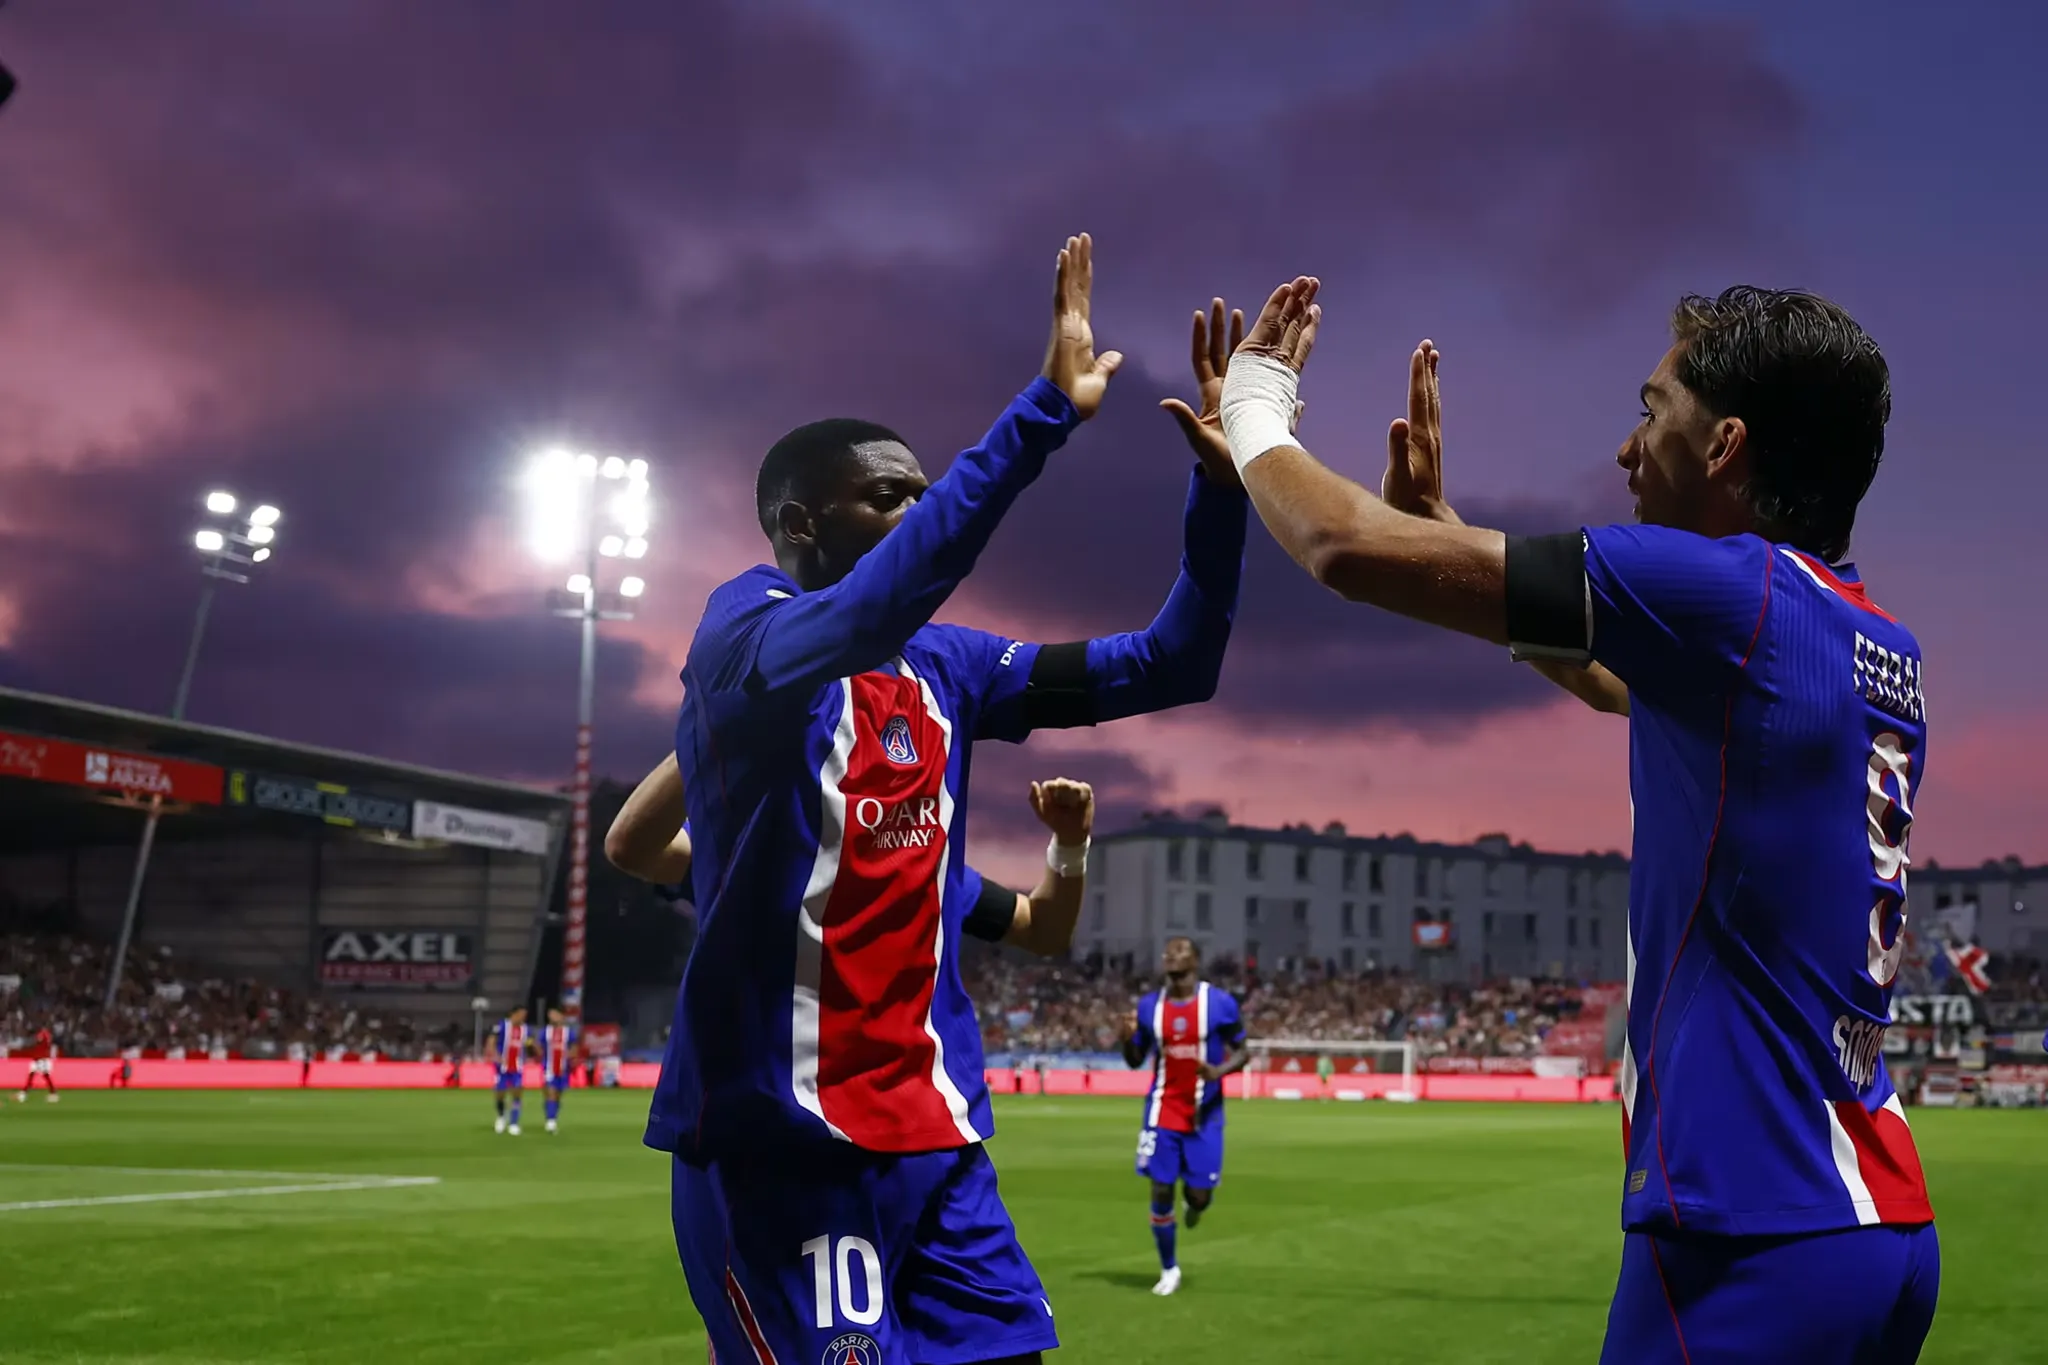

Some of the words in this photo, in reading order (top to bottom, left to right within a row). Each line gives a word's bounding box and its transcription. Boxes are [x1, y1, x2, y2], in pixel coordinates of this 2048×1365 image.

[325, 931, 468, 962] AXEL
[801, 1233, 884, 1329] 10
[831, 1336, 871, 1352] PARIS
